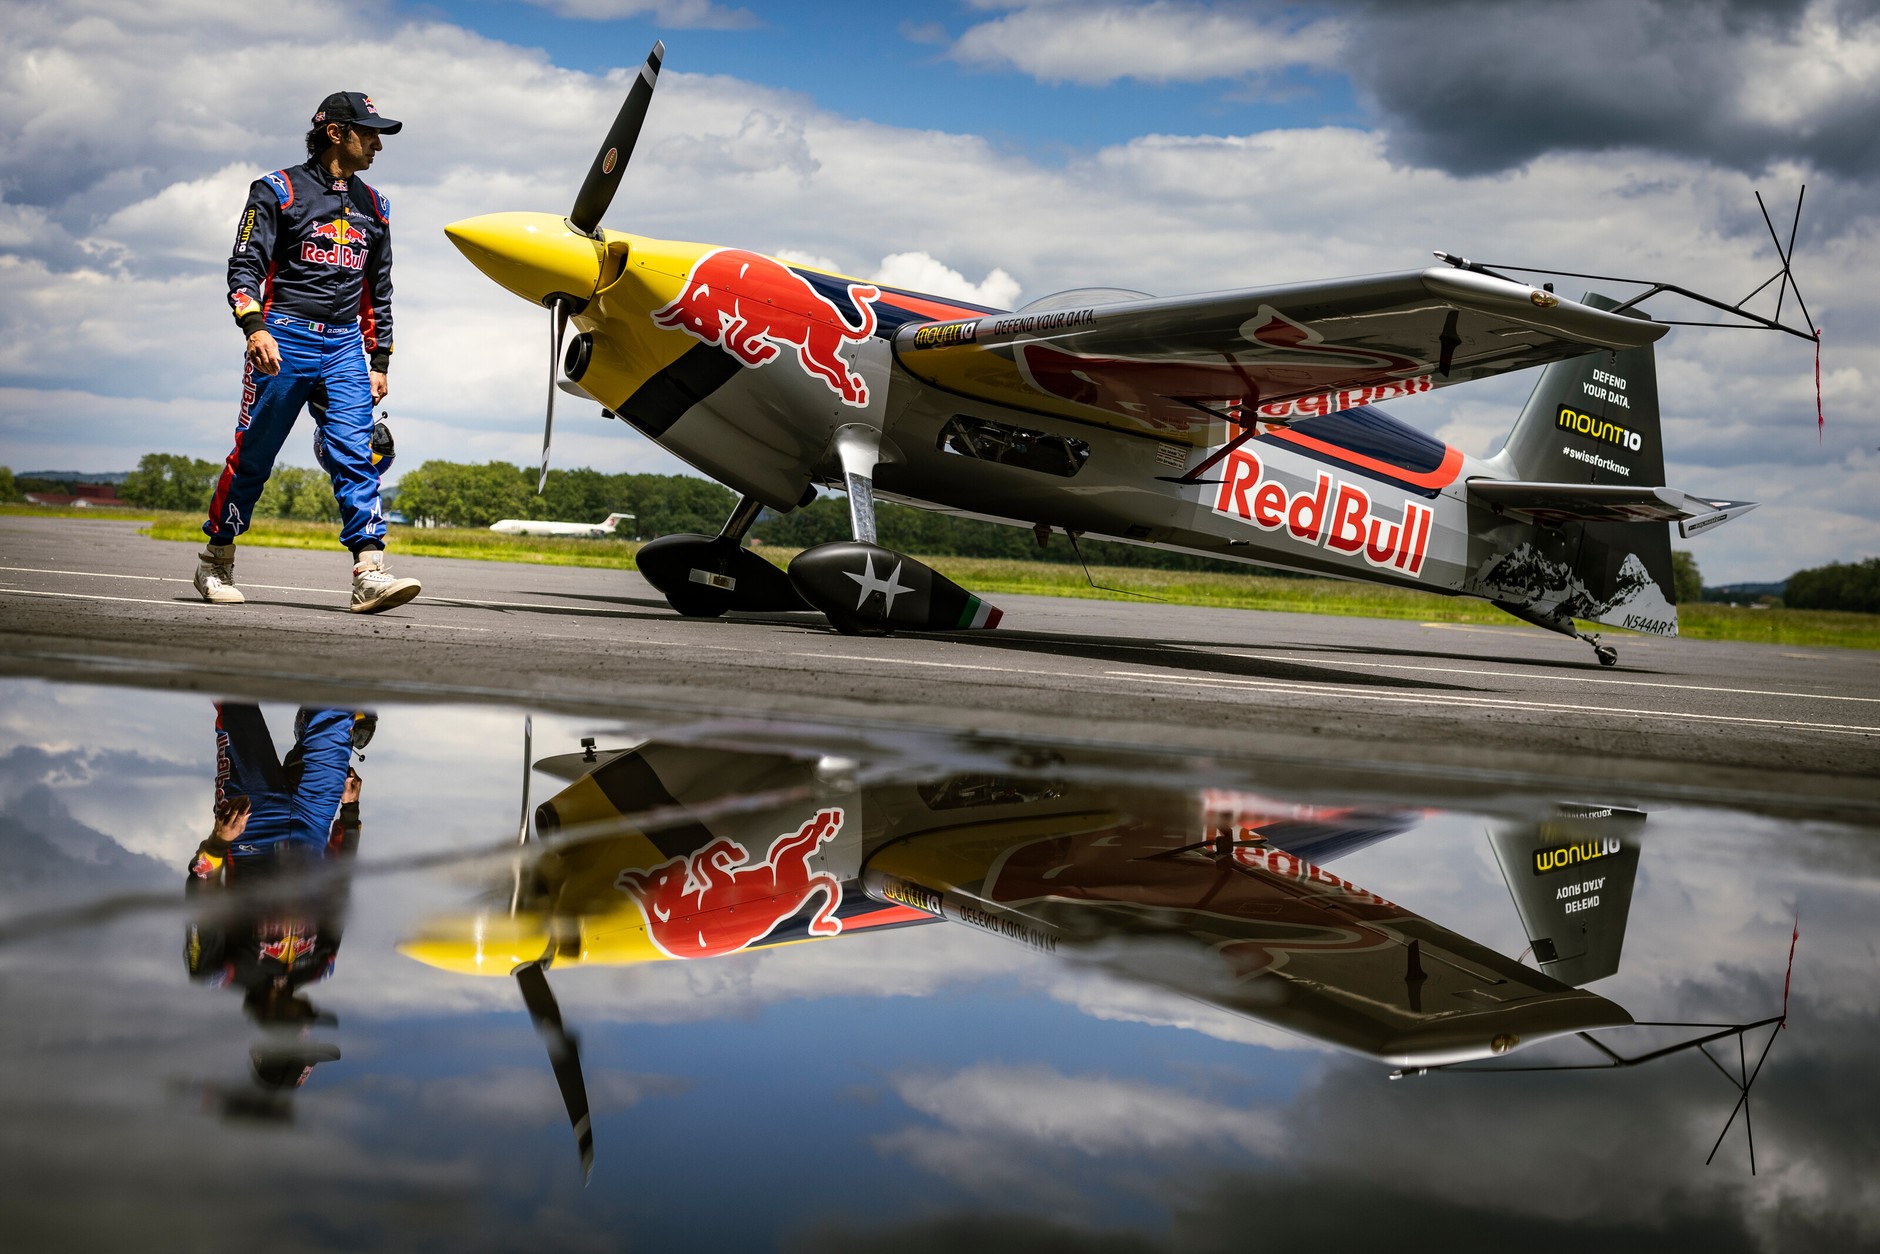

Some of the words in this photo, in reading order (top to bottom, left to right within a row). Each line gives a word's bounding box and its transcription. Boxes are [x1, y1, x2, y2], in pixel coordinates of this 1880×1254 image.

[301, 241, 341, 266] Red
[341, 245, 369, 270] Bull
[915, 321, 977, 345] MOUNT10
[994, 316, 1034, 336] DEFEND
[1036, 313, 1065, 331] YOUR
[1066, 309, 1097, 327] DATA.
[243, 355, 257, 392] ed
[1592, 368, 1627, 390] DEFEND
[240, 386, 255, 429] Bull
[1583, 382, 1608, 400] YOUR
[1608, 391, 1631, 409] DATA.
[1560, 409, 1642, 451] MOUNT10
[1562, 446, 1630, 476] #swissfortknox
[1213, 447, 1332, 545] Red
[1325, 481, 1433, 577] Bull
[1622, 613, 1667, 635] N544AR
